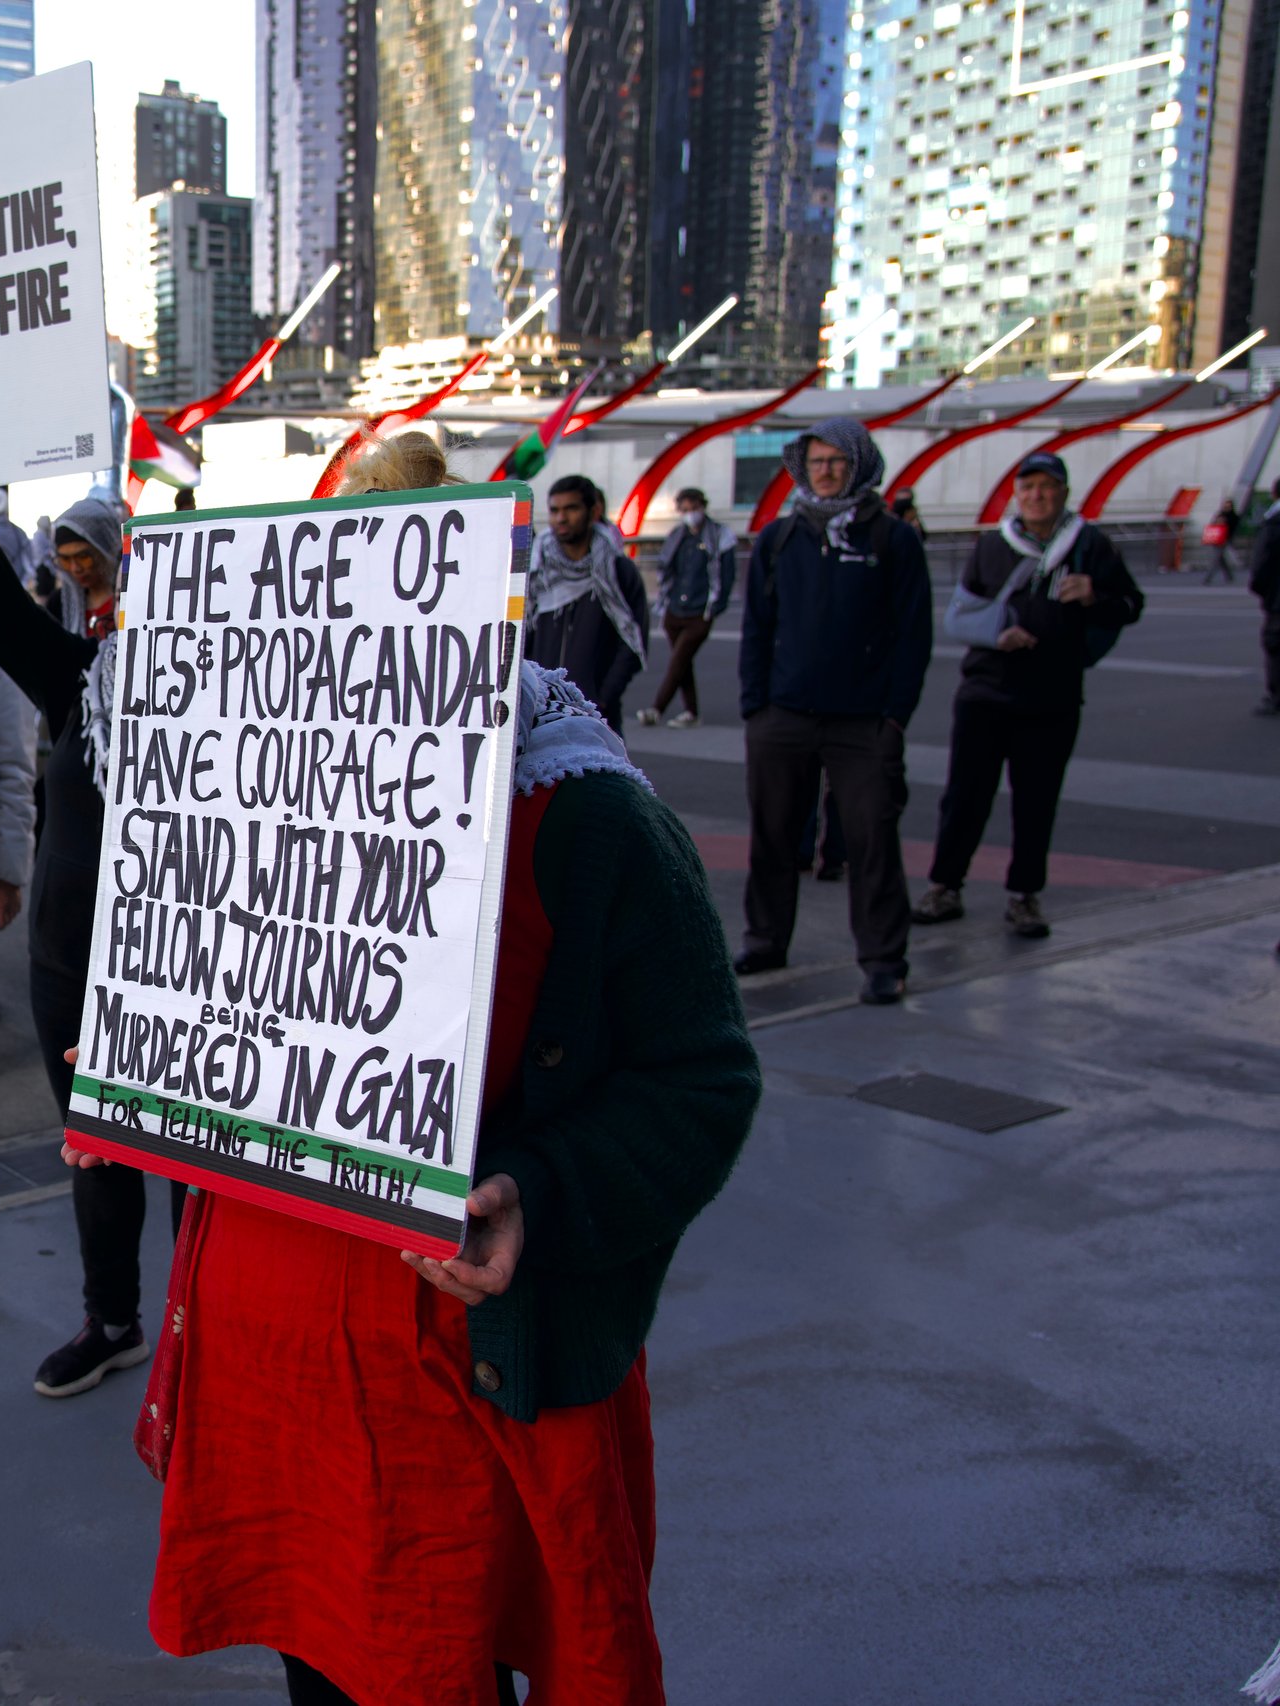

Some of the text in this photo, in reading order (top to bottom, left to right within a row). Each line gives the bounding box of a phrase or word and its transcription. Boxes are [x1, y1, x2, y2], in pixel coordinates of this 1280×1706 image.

[219, 619, 518, 728] PROPAGANDA!
[115, 719, 222, 806] HAVE
[114, 808, 236, 910] STAND
[347, 831, 445, 939] YOUR
[107, 896, 407, 1035] FELLOW JOURNO'S
[88, 985, 456, 1166] MURDERED IN GAZA
[96, 1083, 144, 1131] FOR
[259, 1126, 309, 1173] THE
[320, 1142, 422, 1206] TRUTH!
